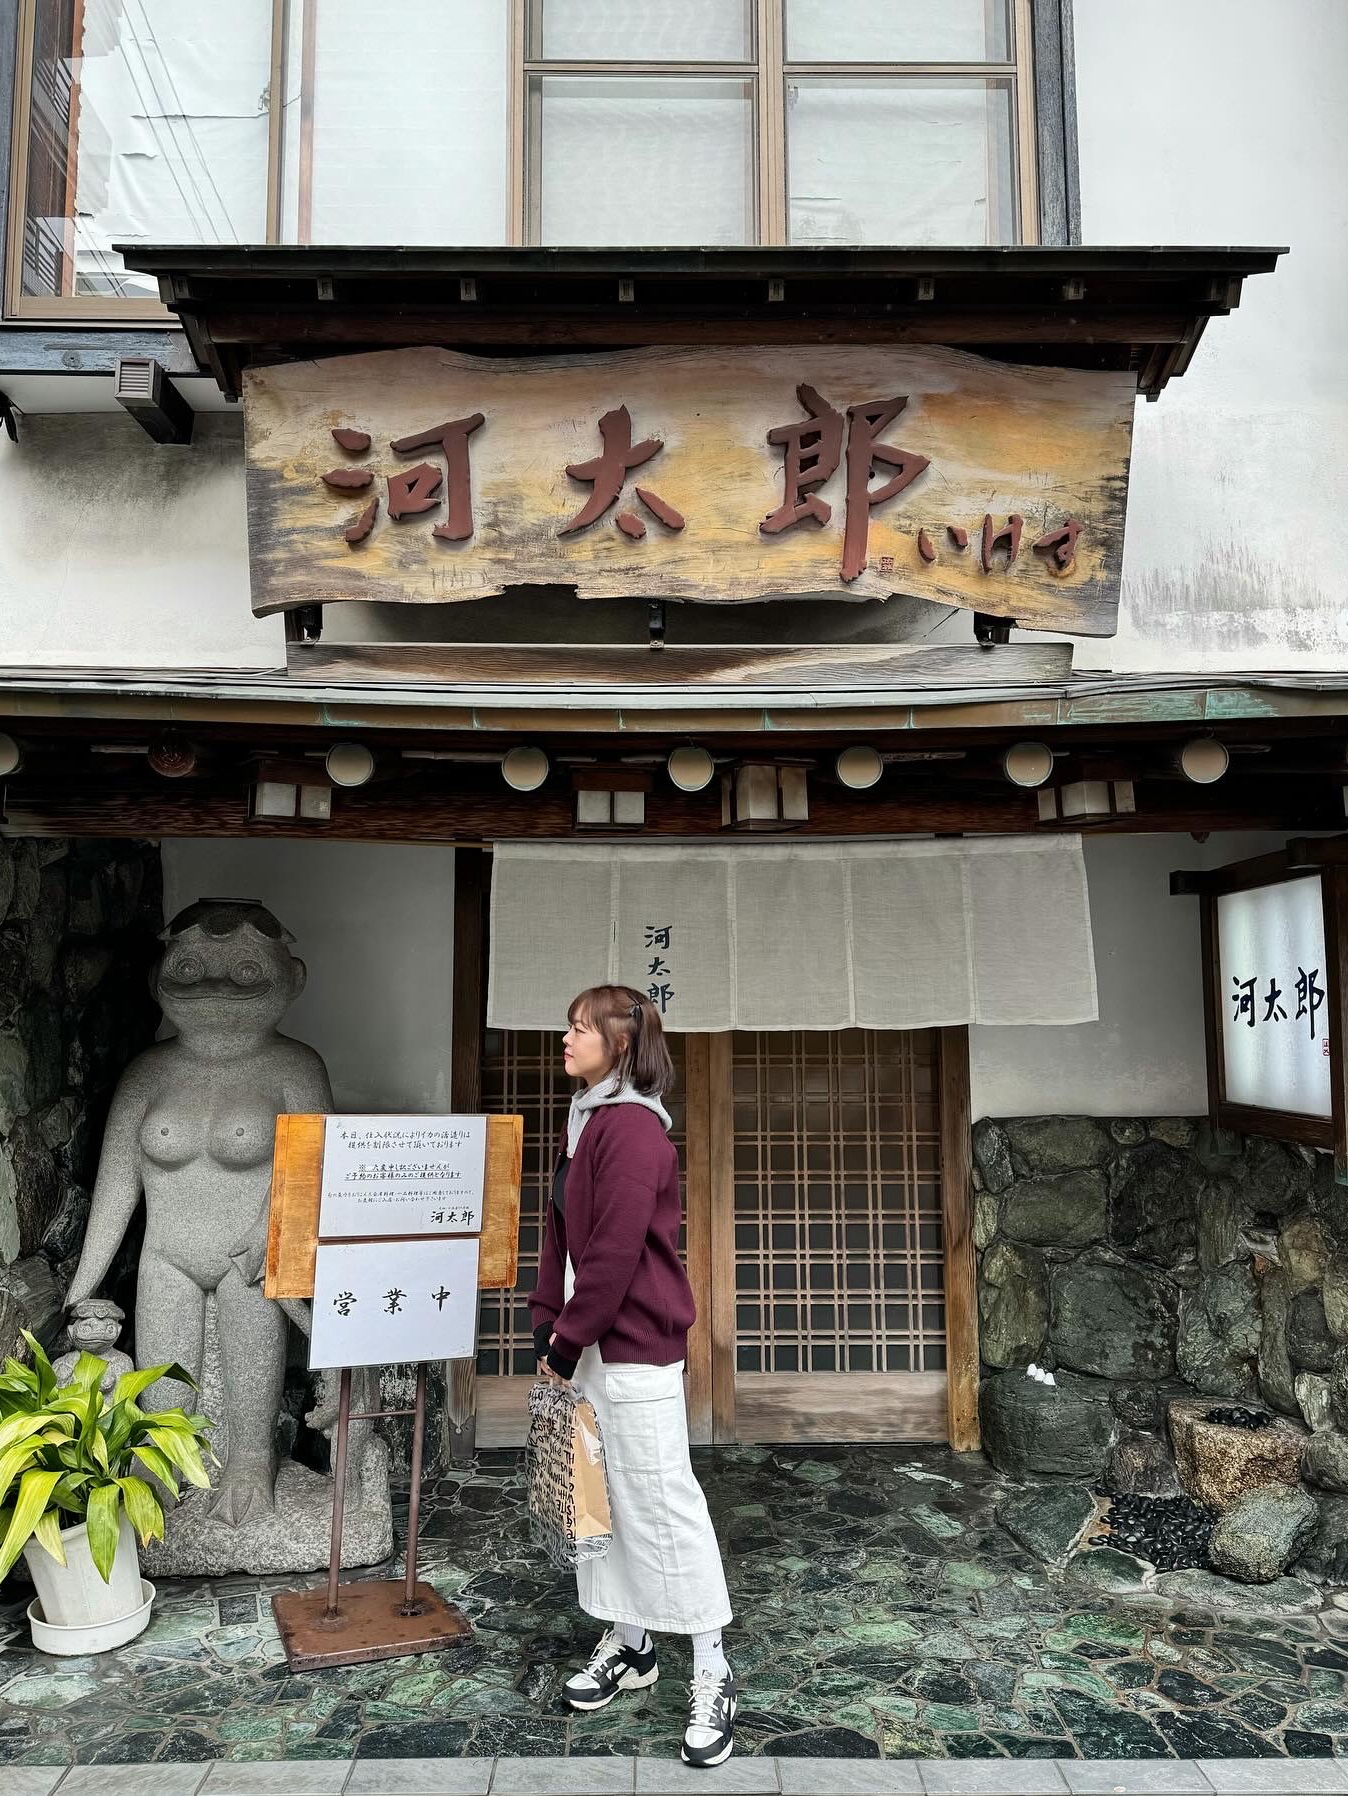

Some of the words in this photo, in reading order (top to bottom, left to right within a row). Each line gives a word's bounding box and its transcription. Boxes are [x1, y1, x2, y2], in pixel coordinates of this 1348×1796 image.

[320, 382, 930, 582] 河太郎
[644, 925, 675, 1014] 河太郎
[1231, 966, 1326, 1041] 河太郎
[430, 1210, 475, 1226] 河太郎
[333, 1285, 451, 1317] 営業中
